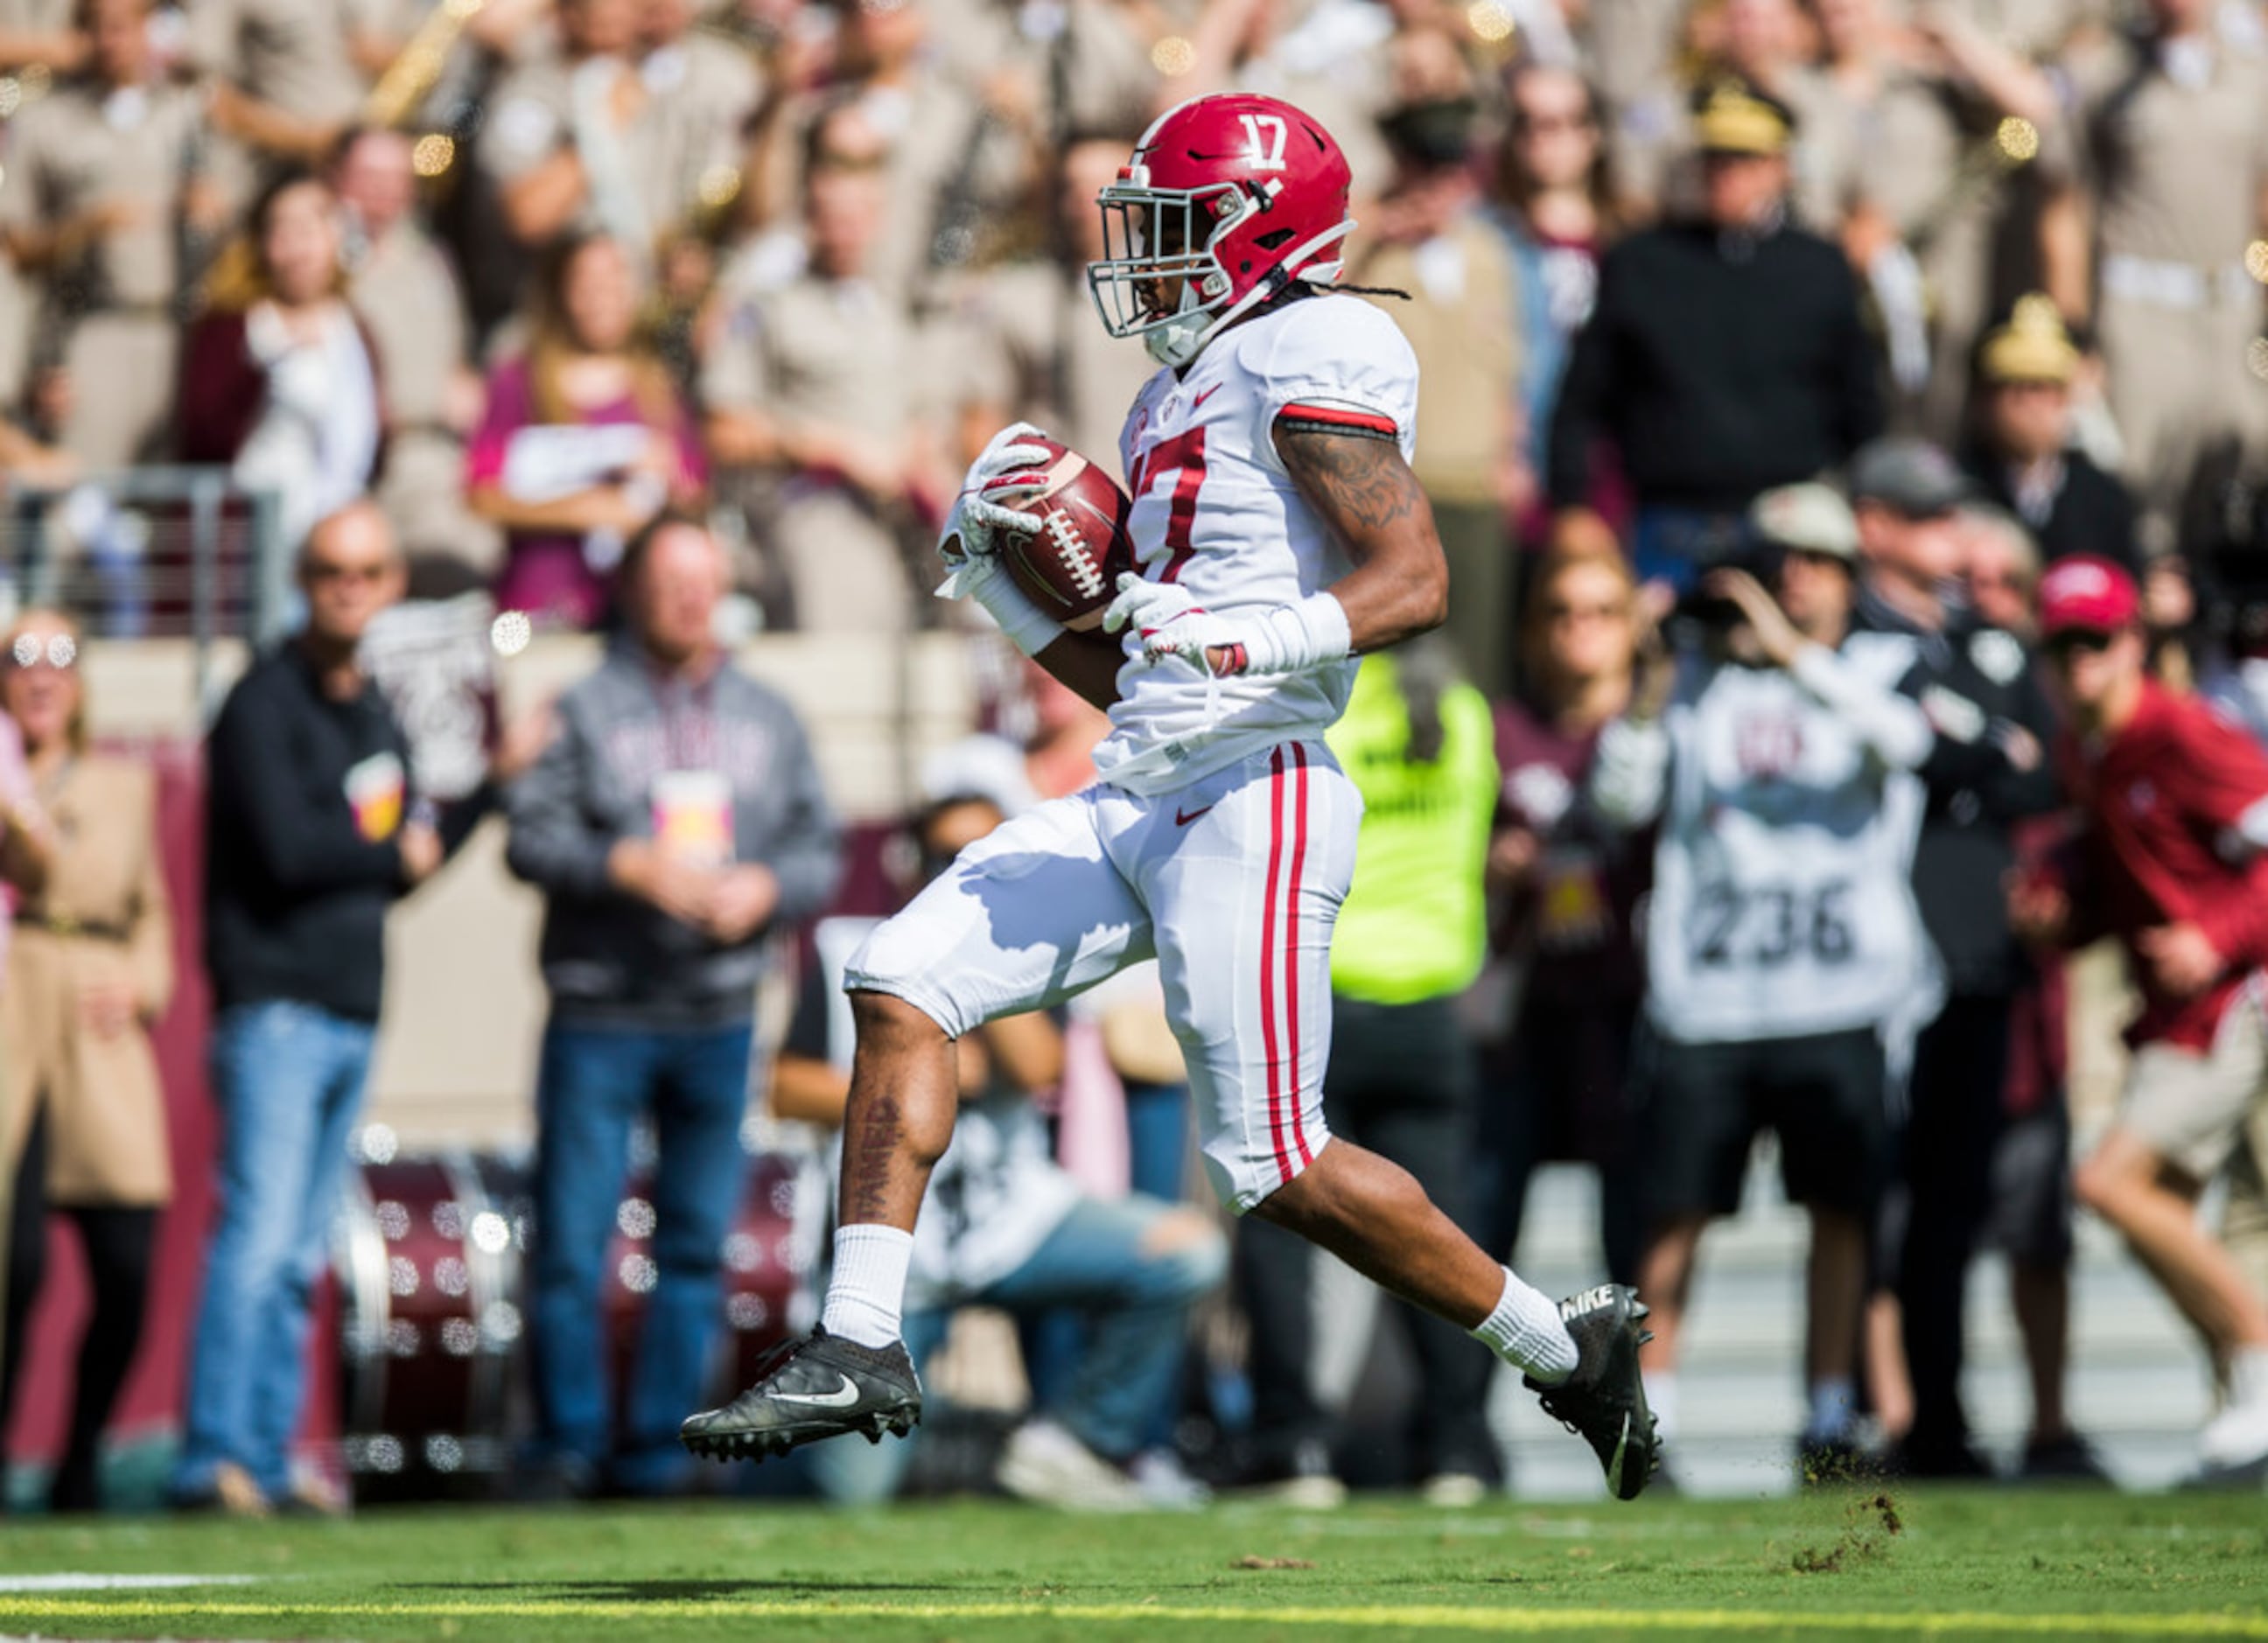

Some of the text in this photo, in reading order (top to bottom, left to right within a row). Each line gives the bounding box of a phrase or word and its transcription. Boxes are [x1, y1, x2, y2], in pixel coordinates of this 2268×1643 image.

[1238, 114, 1287, 170] 17
[1689, 880, 1854, 966] 236
[1561, 1284, 1615, 1324] NIKE
